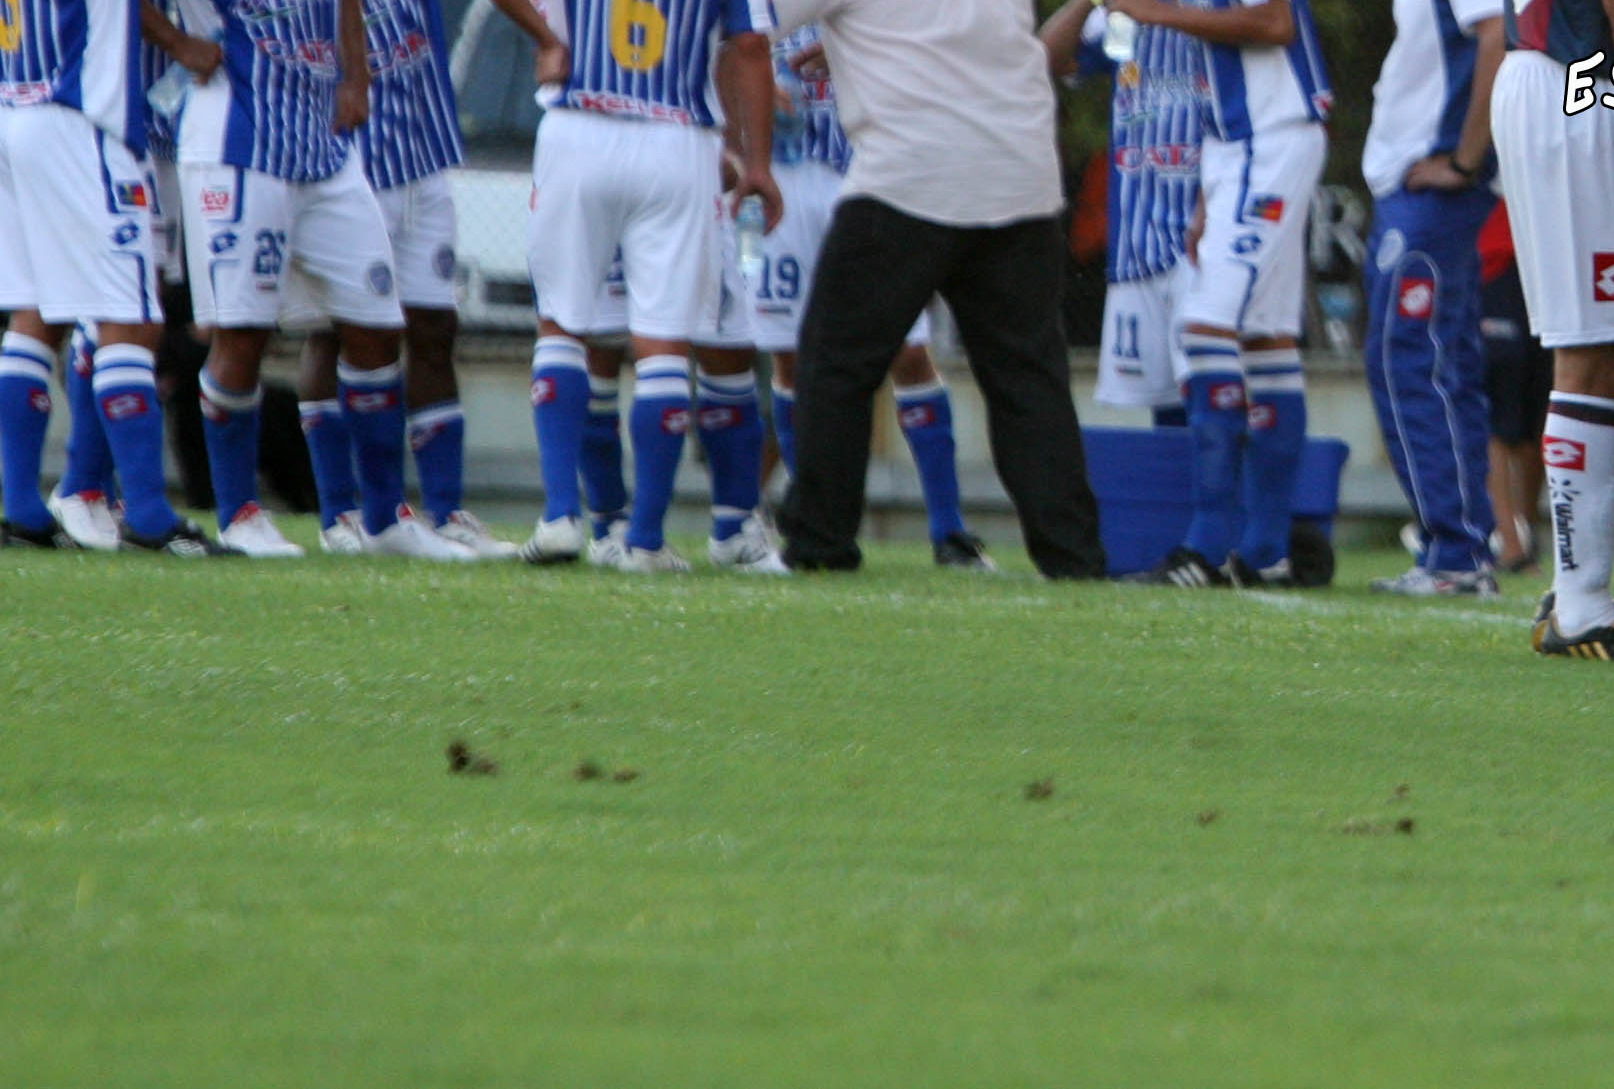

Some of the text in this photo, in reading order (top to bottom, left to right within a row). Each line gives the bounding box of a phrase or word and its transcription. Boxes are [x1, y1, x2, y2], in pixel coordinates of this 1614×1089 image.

[756, 254, 801, 299] 19
[1112, 311, 1140, 359] 11
[1555, 503, 1579, 572] Walmart
